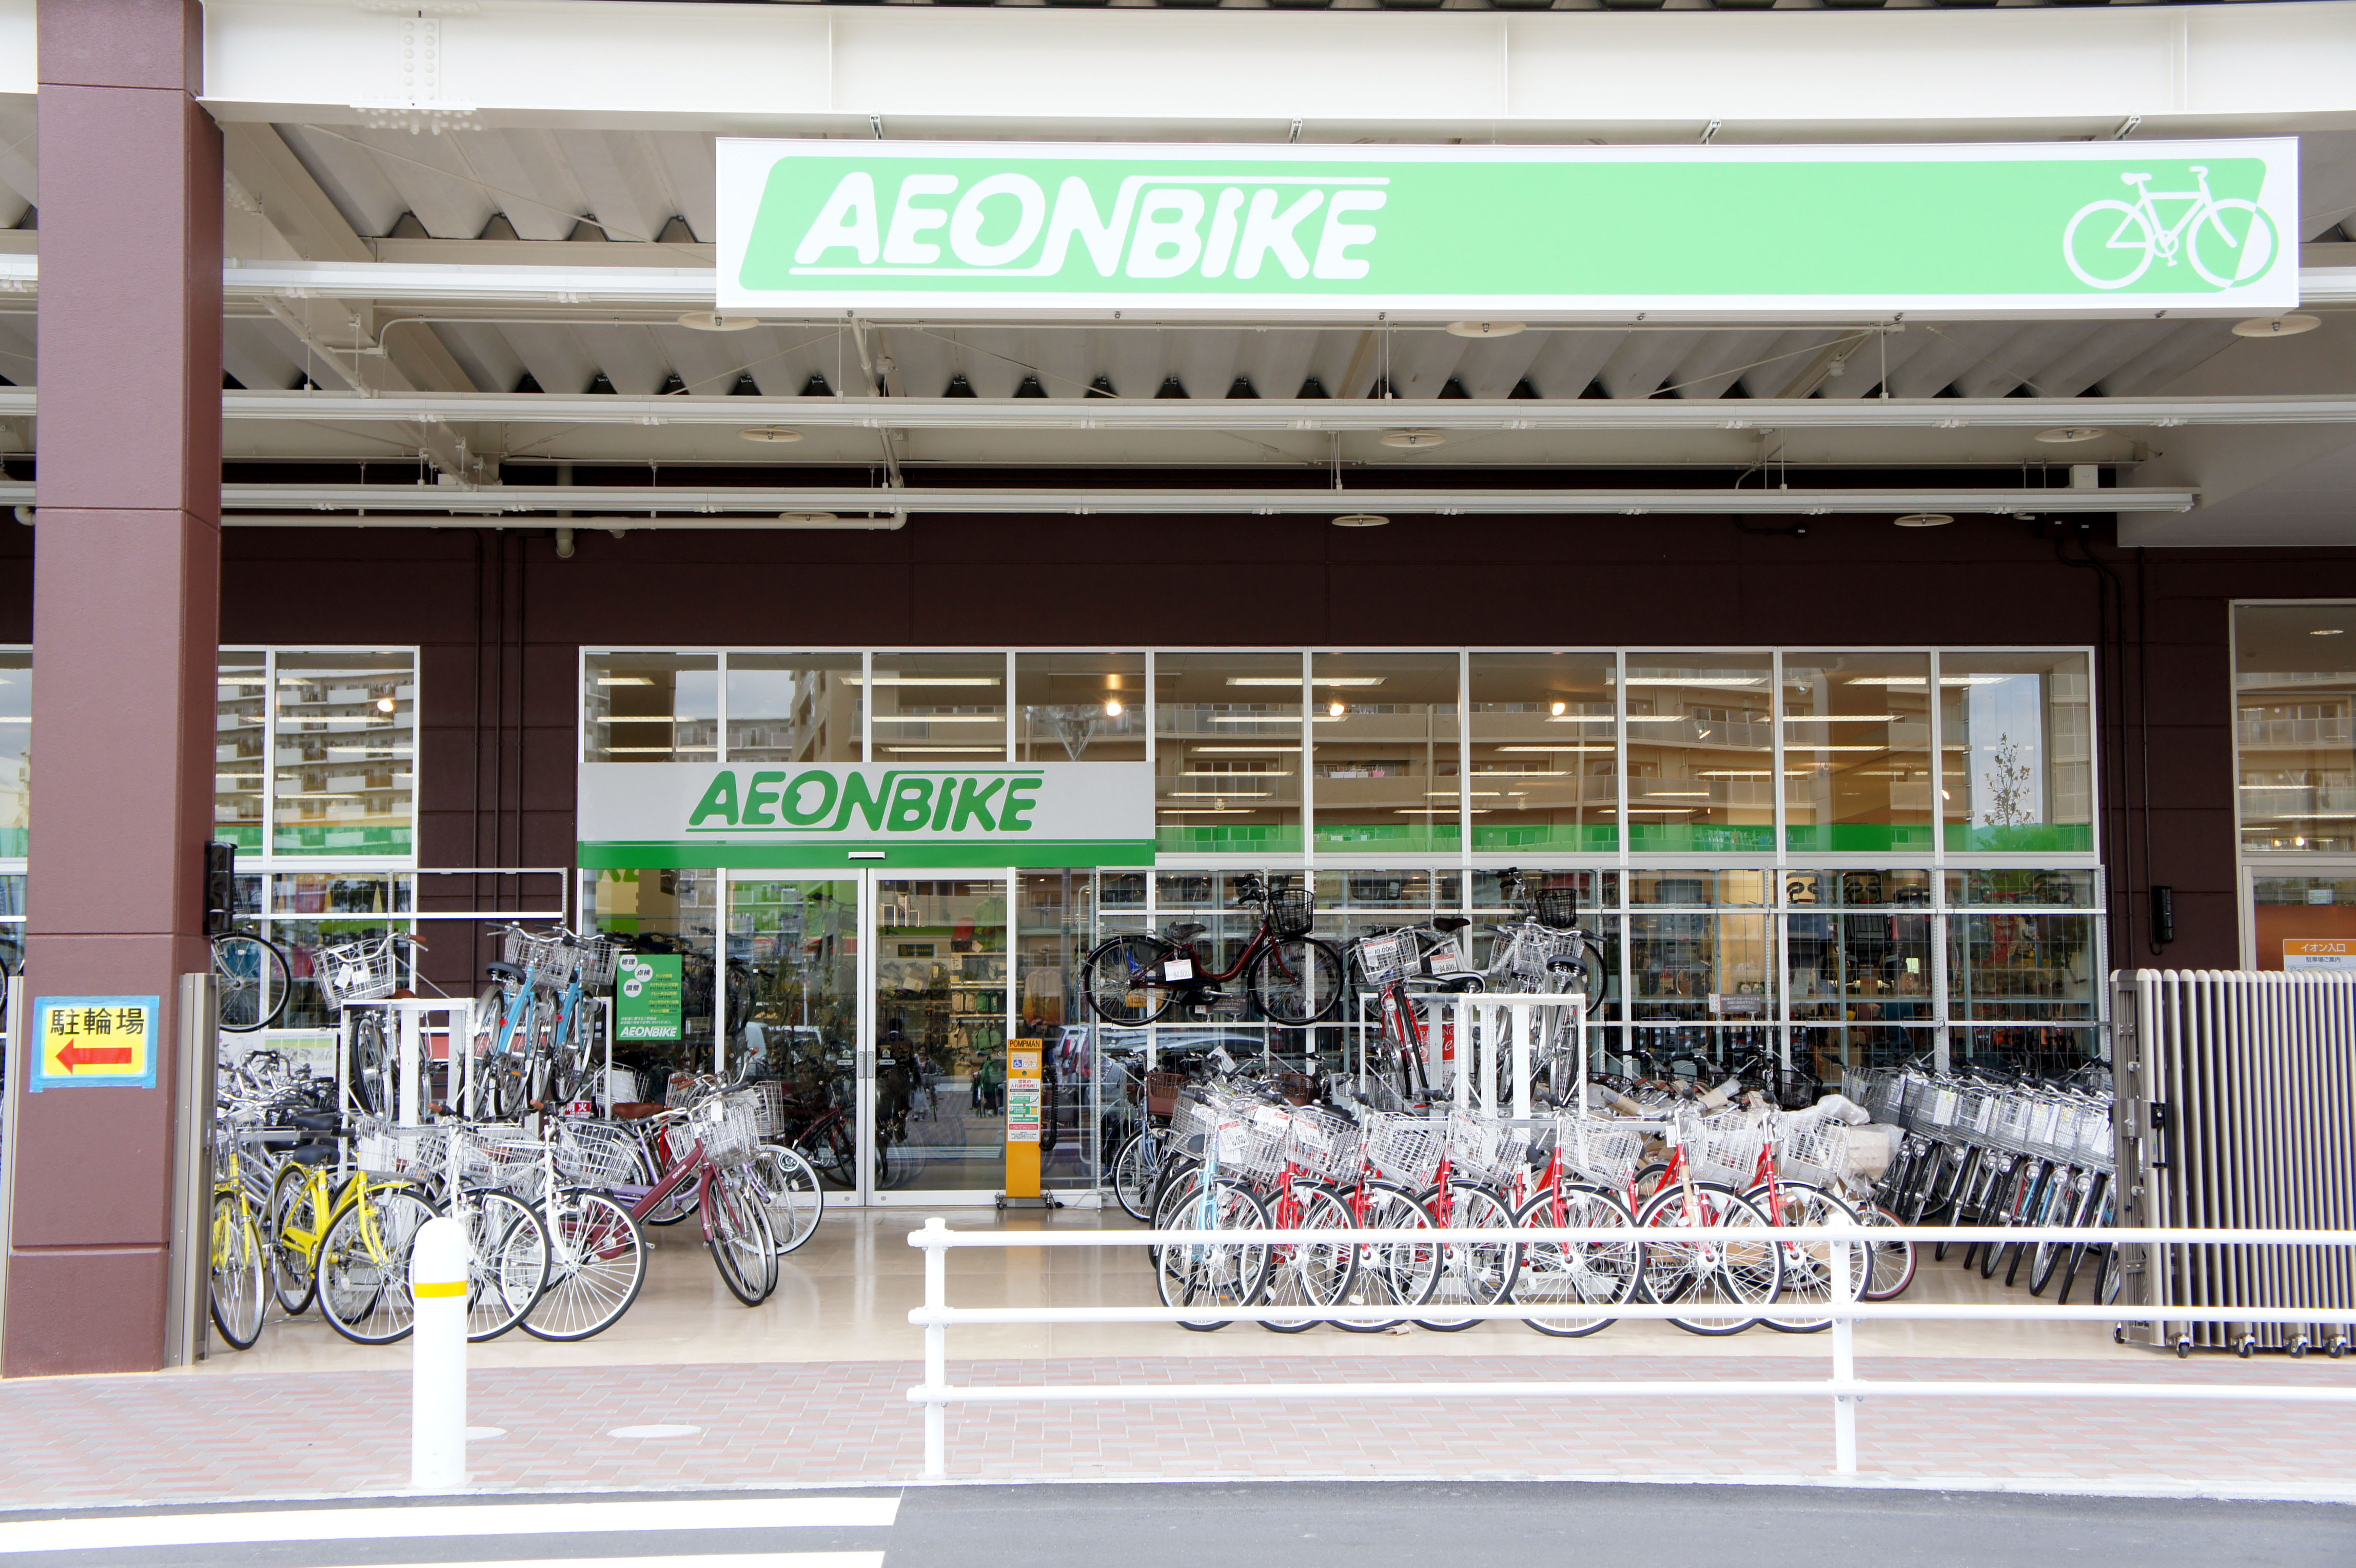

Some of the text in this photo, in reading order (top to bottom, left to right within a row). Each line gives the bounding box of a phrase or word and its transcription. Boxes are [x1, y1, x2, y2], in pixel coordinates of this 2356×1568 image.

[789, 171, 1390, 279] AEONBIKE
[685, 770, 1045, 832] AEONBIKE
[2301, 943, 2346, 952] イオン入口
[50, 1007, 145, 1036] 駐輪場
[620, 1026, 678, 1037] AEONBIKE
